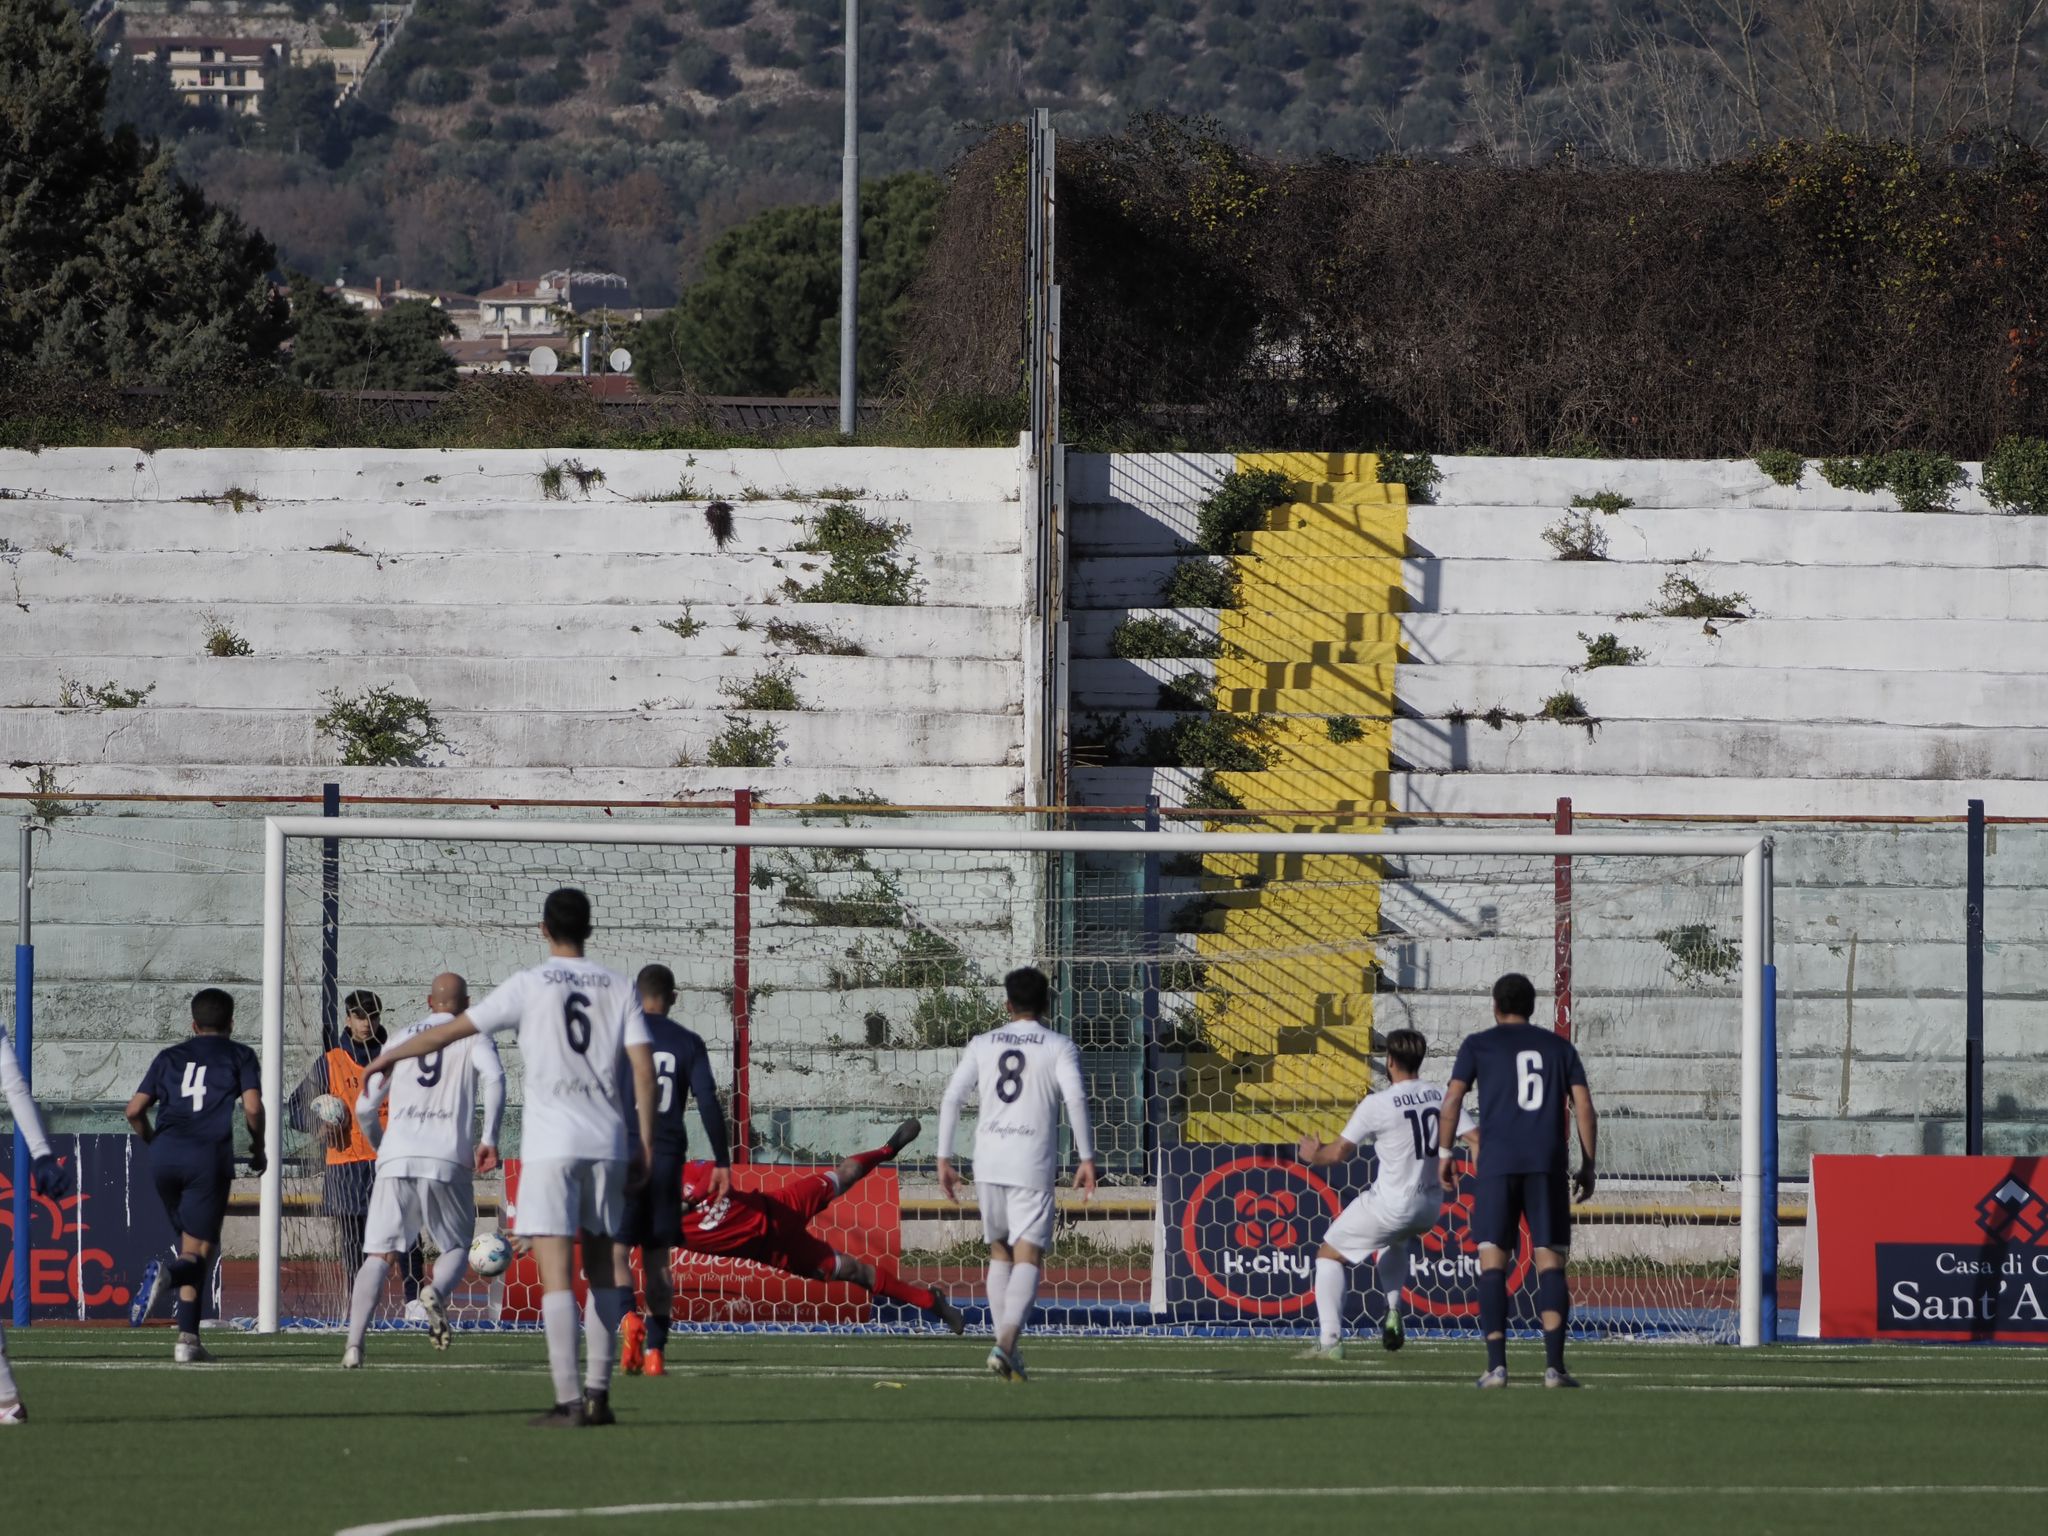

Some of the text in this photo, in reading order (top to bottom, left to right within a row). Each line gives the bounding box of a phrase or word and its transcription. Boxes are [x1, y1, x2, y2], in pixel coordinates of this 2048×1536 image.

[564, 991, 592, 1054] 6
[181, 1062, 208, 1112] 4
[417, 1049, 444, 1088] 9
[996, 1049, 1026, 1104] 8
[1516, 1050, 1544, 1112] 6
[1403, 1106, 1441, 1161] 10
[1936, 1252, 1993, 1275] Casa
[2001, 1253, 2023, 1275] di
